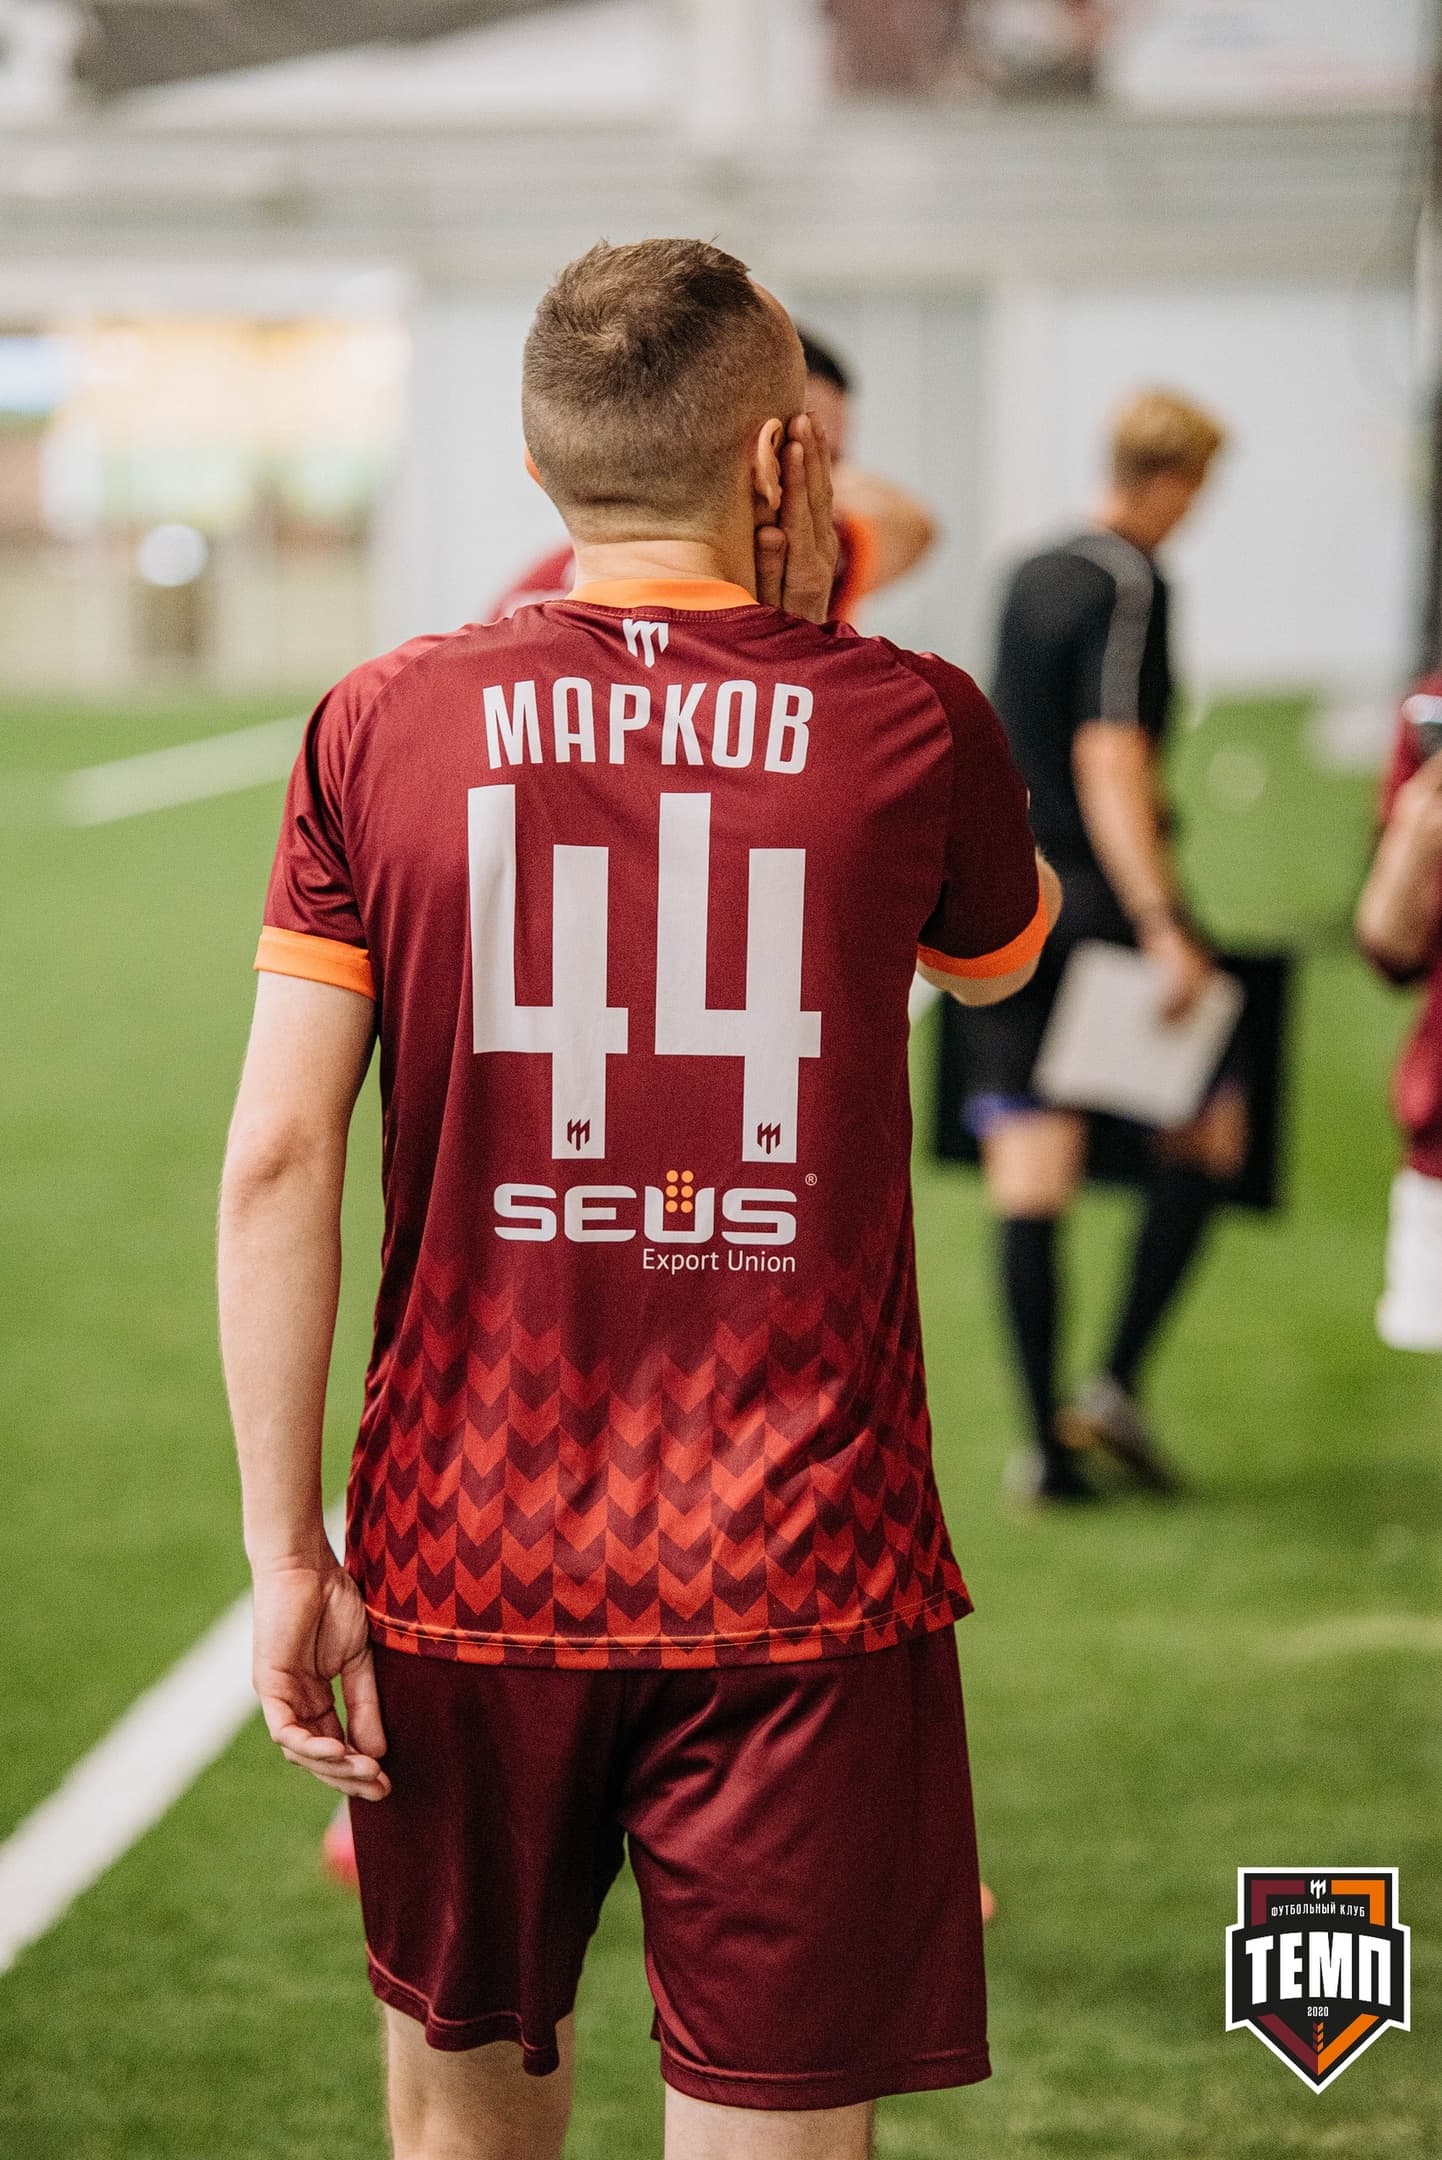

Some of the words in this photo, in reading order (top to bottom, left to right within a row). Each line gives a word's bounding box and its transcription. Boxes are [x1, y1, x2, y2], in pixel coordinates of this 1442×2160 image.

[483, 677, 814, 774] МАРКОВ
[468, 784, 822, 1163] 44
[493, 1182, 797, 1246] SEUS
[642, 1248, 719, 1275] Export
[728, 1251, 796, 1273] Union
